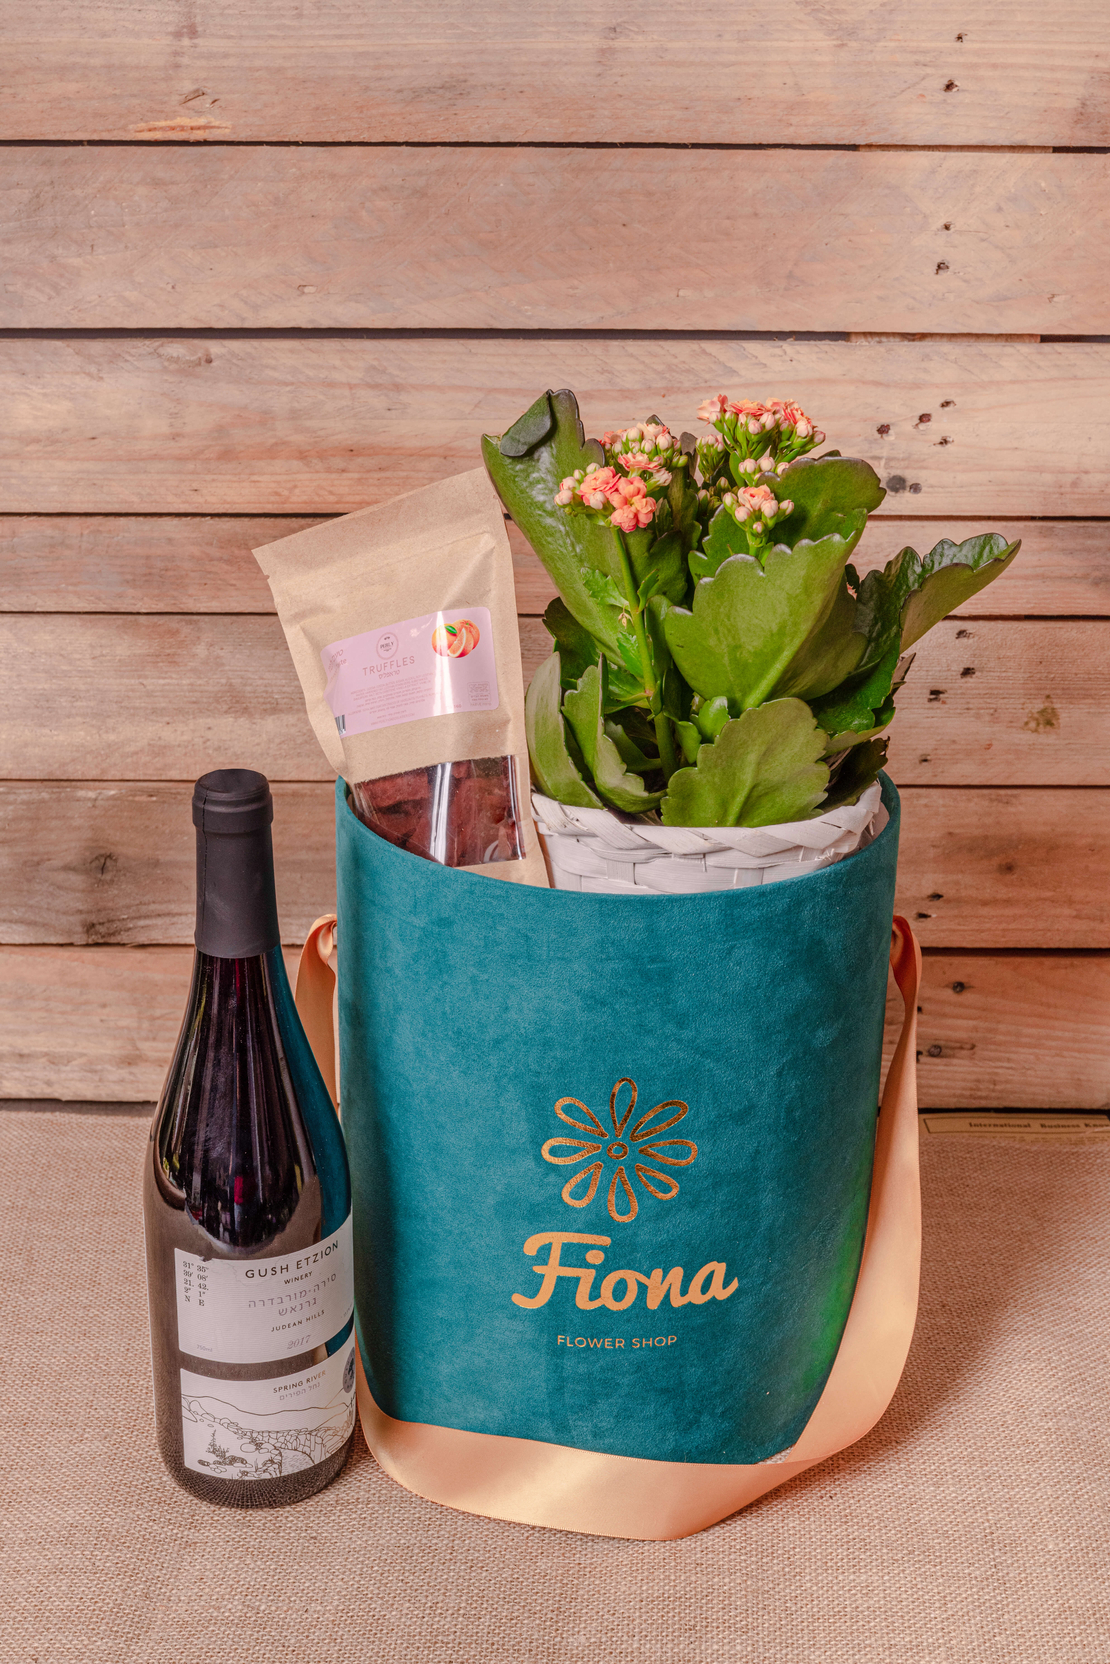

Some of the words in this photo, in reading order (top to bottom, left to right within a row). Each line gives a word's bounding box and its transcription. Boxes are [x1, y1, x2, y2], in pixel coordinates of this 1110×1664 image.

[362, 655, 415, 676] TRUFFLES
[968, 1121, 1031, 1129] International
[245, 1264, 289, 1279] GUSH
[296, 1240, 339, 1270] ETZION
[284, 1271, 313, 1285] WINERY
[511, 1231, 739, 1311] Fiona
[278, 1297, 317, 1317] גרנאש
[271, 1319, 303, 1332] JUDEAN
[305, 1309, 325, 1322] HILLS
[287, 1334, 311, 1350] 2017
[557, 1334, 625, 1349] FLOWER
[632, 1335, 678, 1349] SHOP
[273, 1380, 304, 1394] SPRING
[306, 1369, 326, 1384] RIVER
